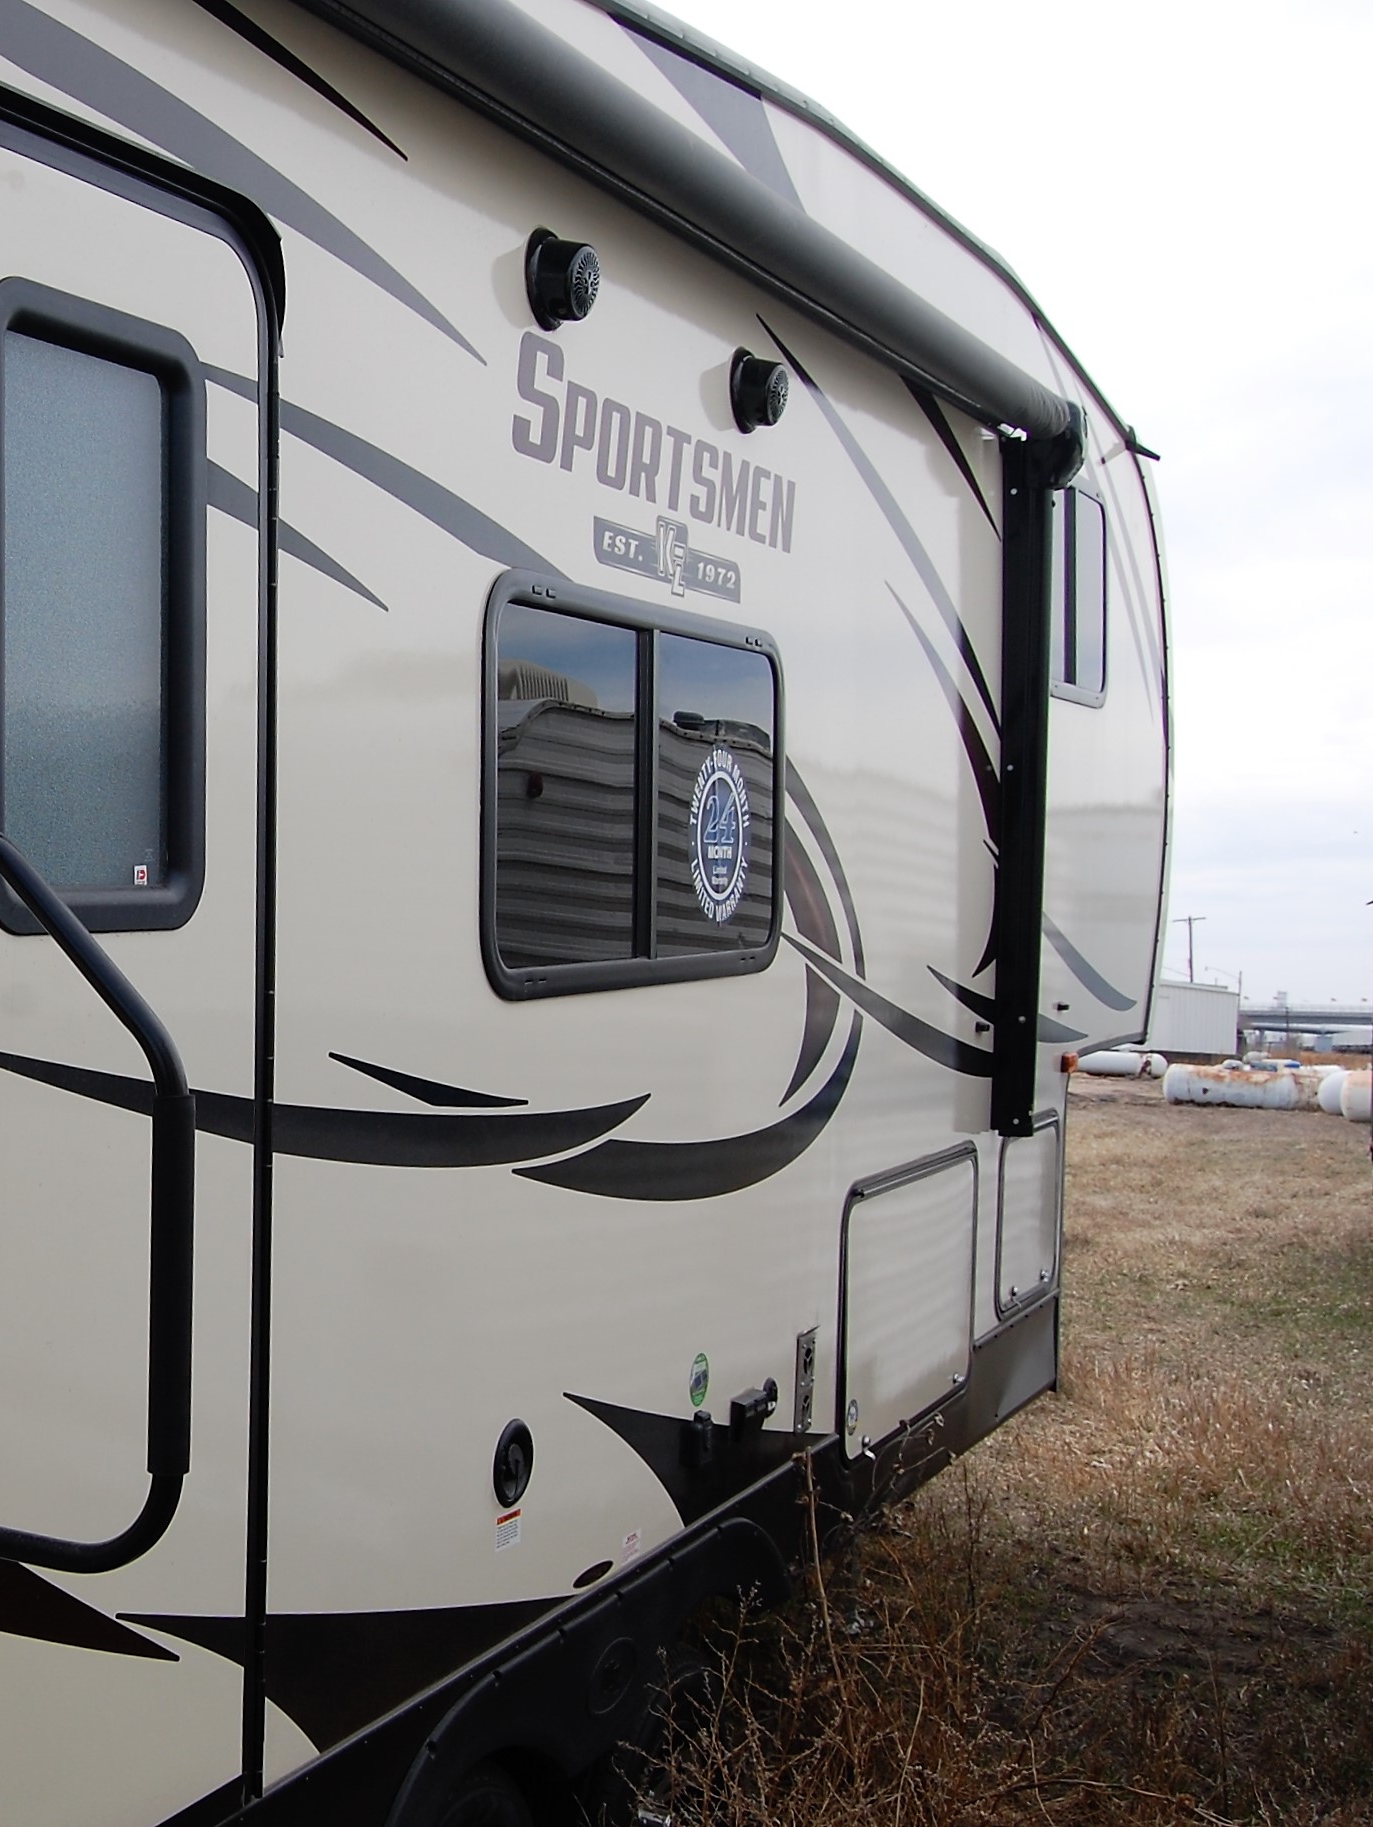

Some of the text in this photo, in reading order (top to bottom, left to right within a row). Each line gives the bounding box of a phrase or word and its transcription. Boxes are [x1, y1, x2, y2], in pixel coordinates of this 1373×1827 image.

[602, 530, 643, 562] EST.
[697, 562, 736, 589] 1972
[689, 749, 750, 828] TWENTY-FOUR MONTH
[703, 791, 737, 843] 24
[708, 845, 732, 859] MONTH
[691, 856, 748, 922] LIMITED WARRANTY
